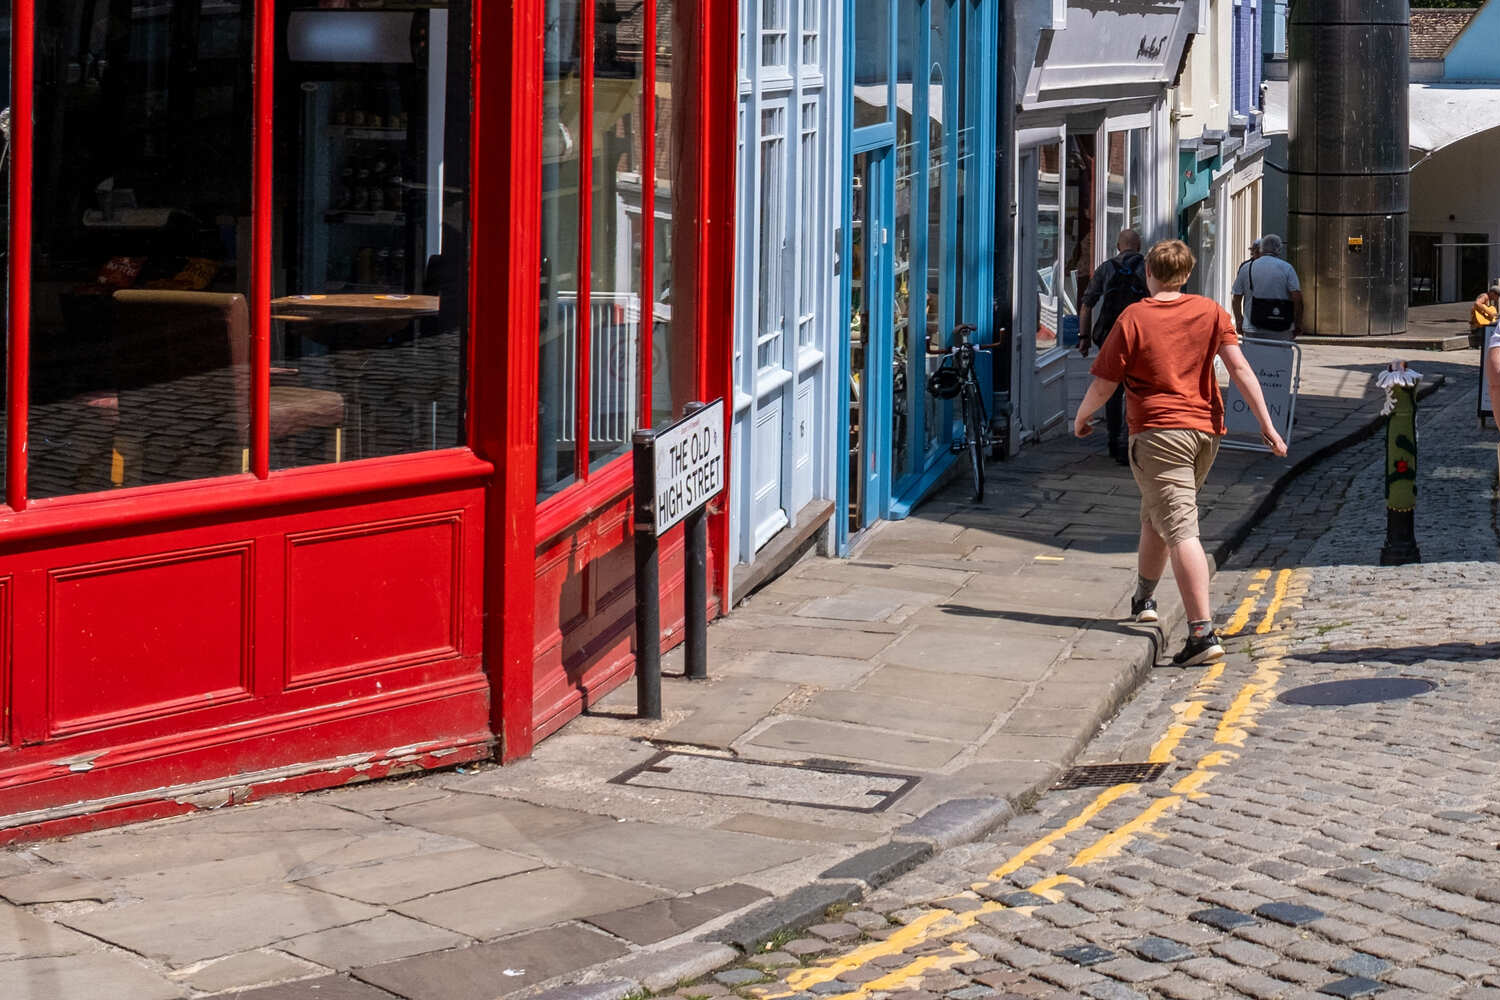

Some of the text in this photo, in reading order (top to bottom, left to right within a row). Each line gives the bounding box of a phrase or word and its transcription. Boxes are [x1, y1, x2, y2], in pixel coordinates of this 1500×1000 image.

[669, 438, 688, 478] THE
[691, 426, 711, 465] OLD
[658, 455, 721, 527] HIGH STREET
